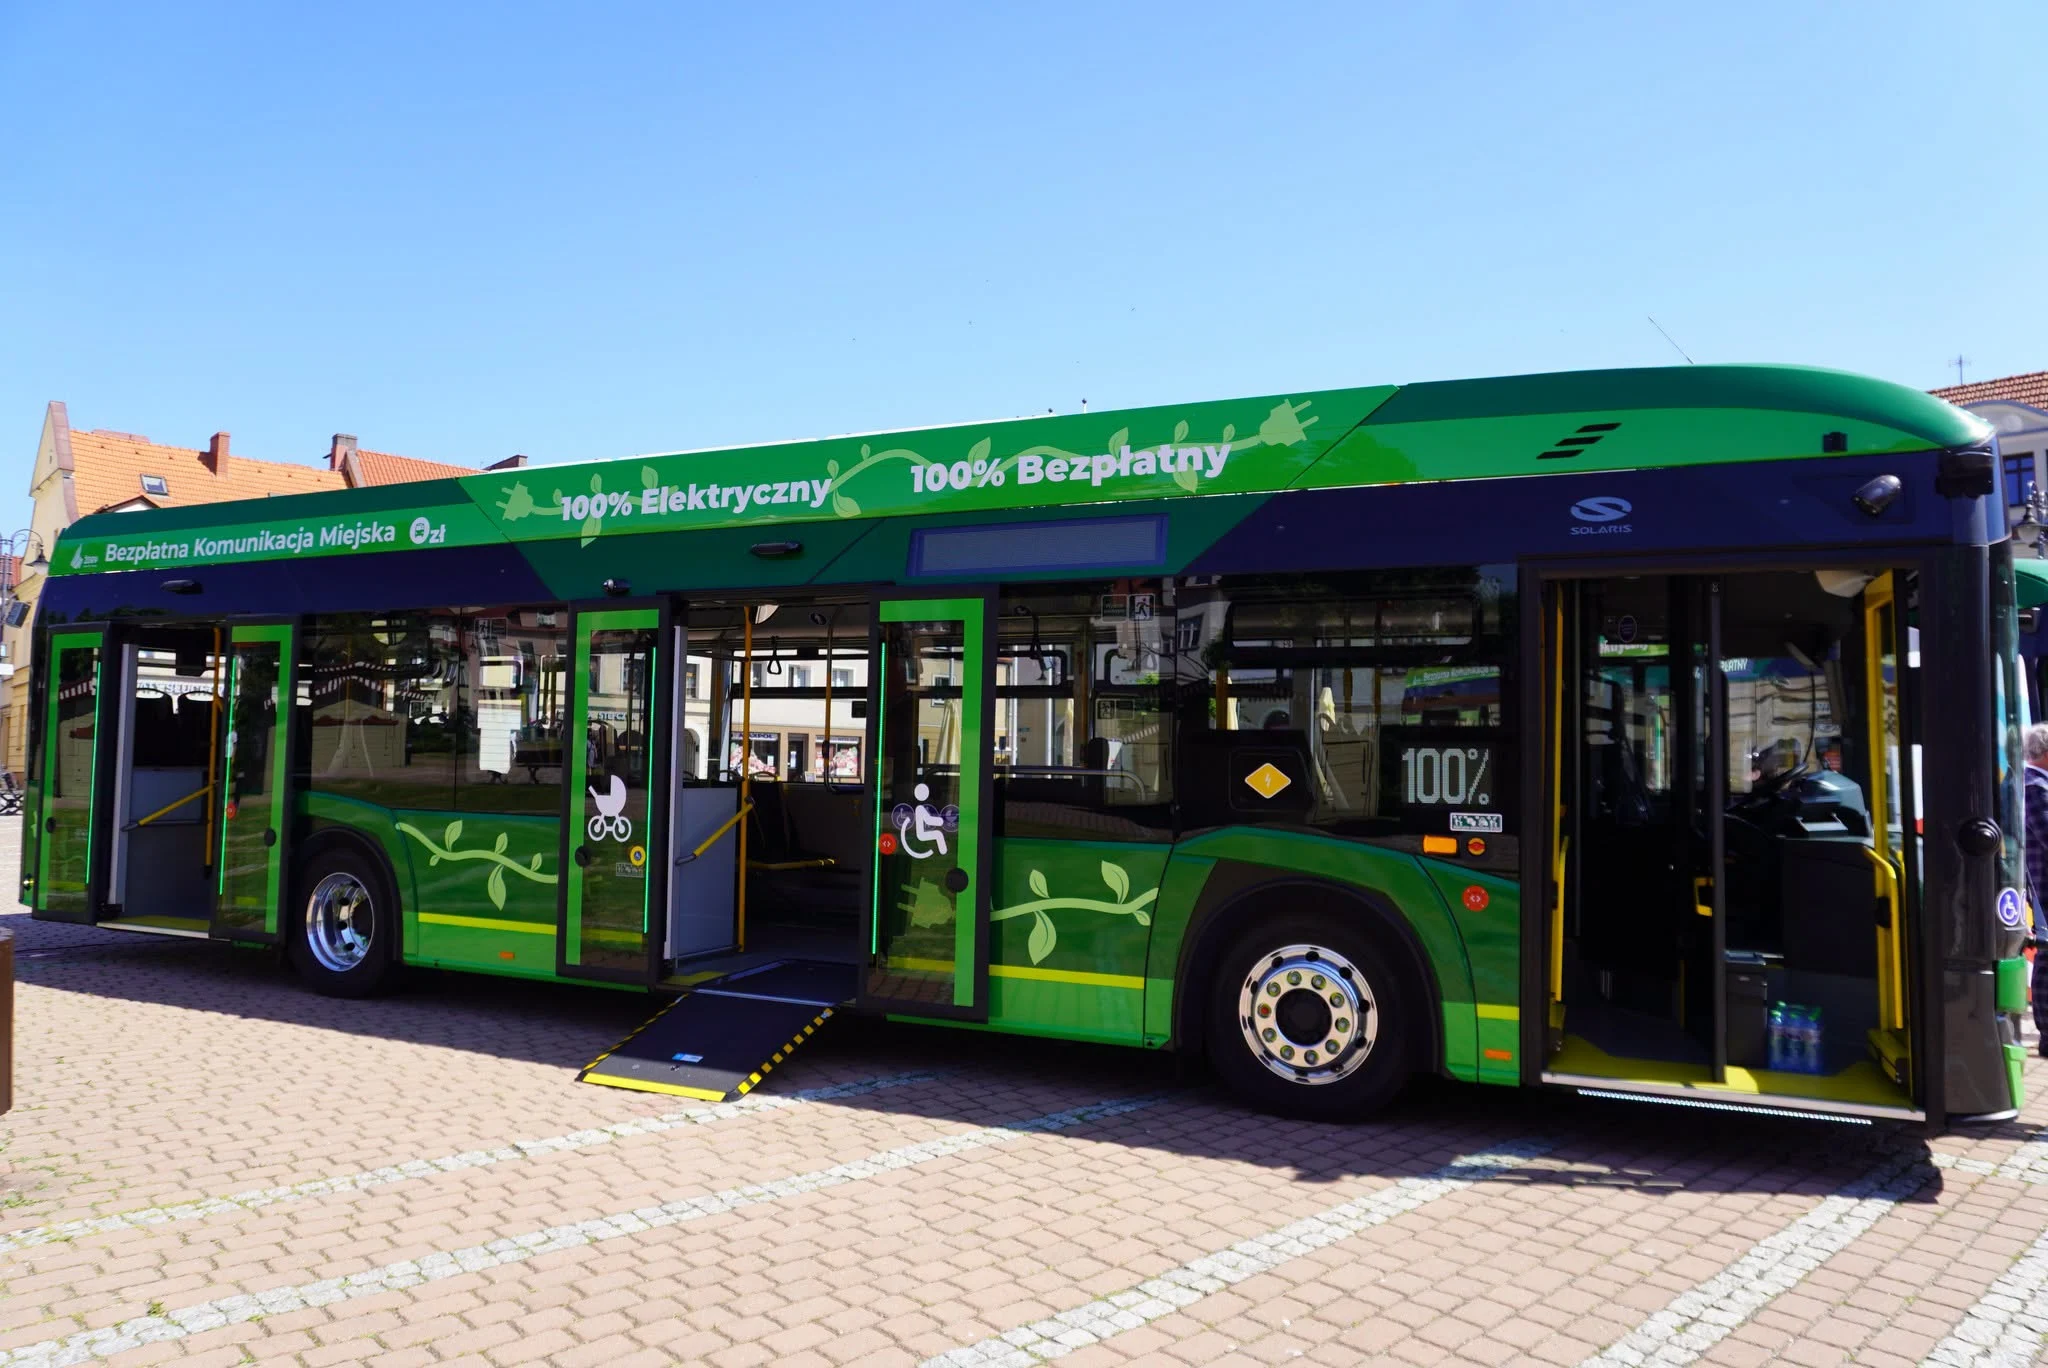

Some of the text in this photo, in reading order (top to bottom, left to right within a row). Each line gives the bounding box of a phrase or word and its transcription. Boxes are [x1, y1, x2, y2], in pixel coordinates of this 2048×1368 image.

[910, 444, 1232, 493] 100% Bezpłatny
[561, 478, 832, 521] 100% Elektryczny
[104, 541, 189, 565] Bezpłatna
[194, 526, 314, 557] Komunikacja
[319, 521, 396, 549] Miejska
[1570, 524, 1633, 536] SOLARIS
[1402, 748, 1490, 805] 100%
